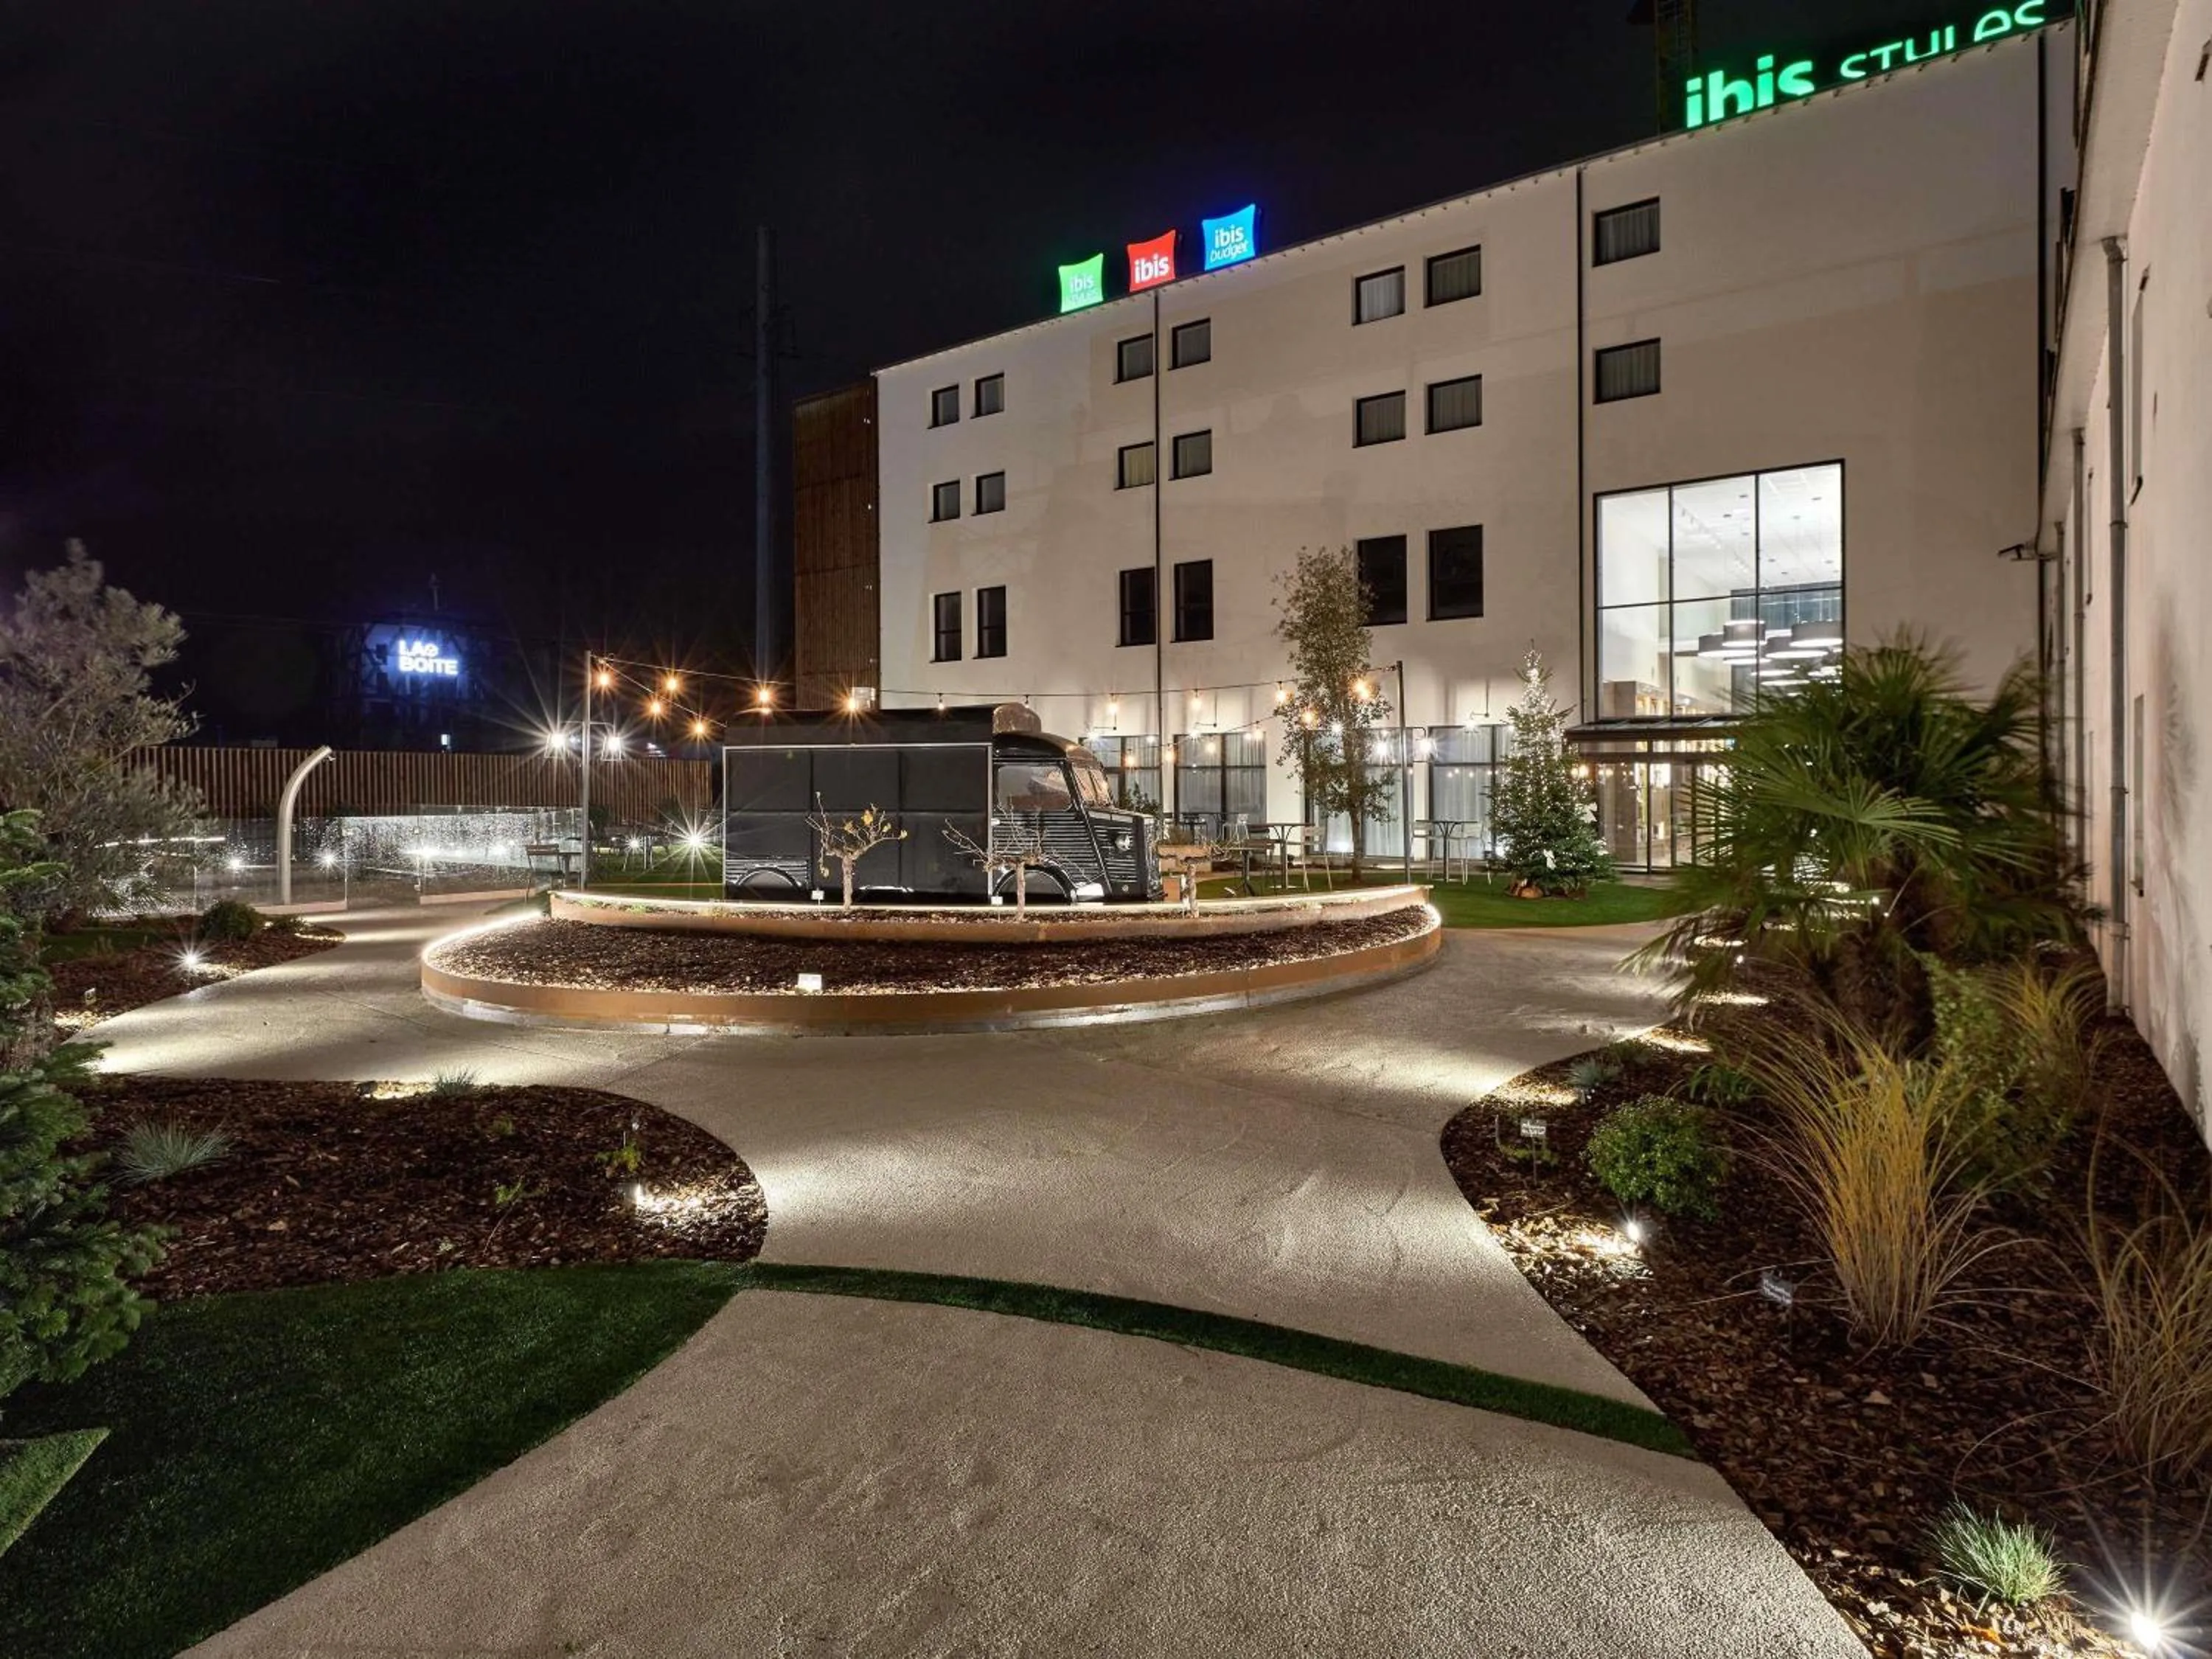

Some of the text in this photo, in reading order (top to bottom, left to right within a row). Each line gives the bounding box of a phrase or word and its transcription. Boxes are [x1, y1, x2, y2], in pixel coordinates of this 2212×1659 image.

[1214, 223, 1245, 248] ibis
[1210, 239, 1249, 263] budget
[1134, 253, 1169, 284] ibis
[1070, 273, 1094, 293] ibis
